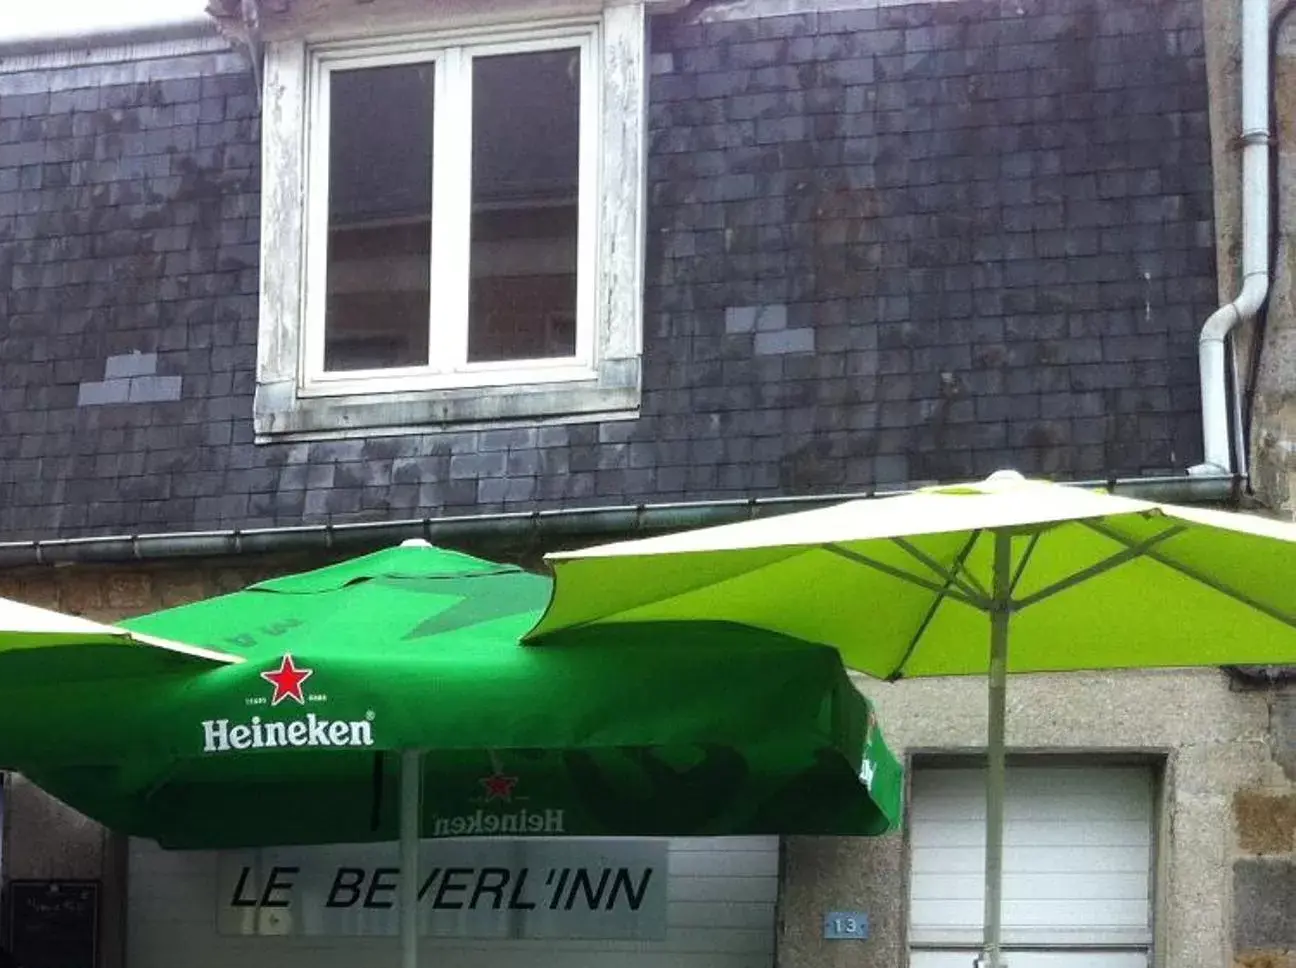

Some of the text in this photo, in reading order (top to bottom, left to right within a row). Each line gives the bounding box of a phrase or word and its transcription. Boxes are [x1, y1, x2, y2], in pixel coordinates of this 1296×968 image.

[202, 713, 374, 751] Heineken
[230, 866, 301, 908] LE
[834, 918, 857, 933] 13
